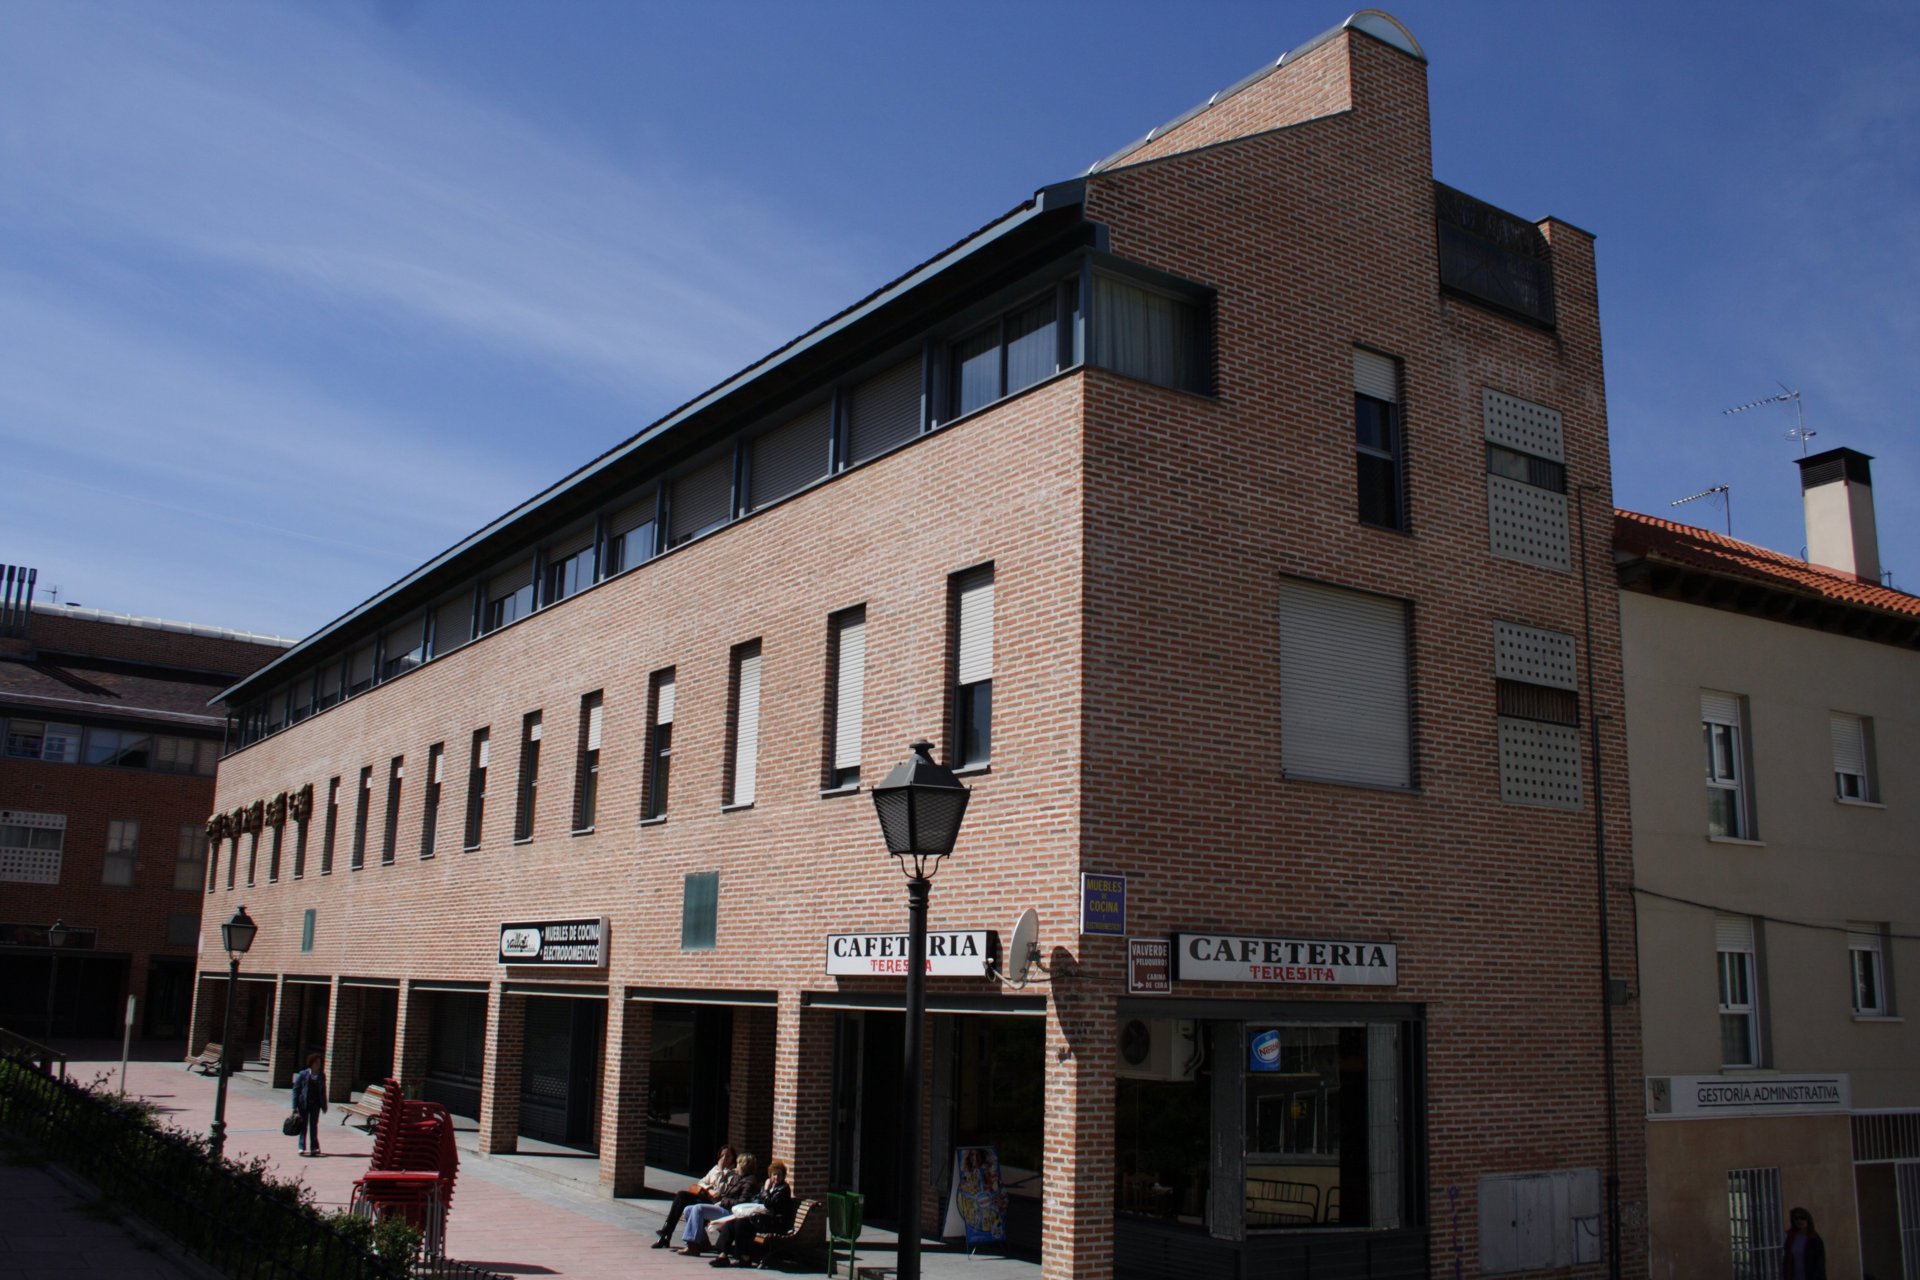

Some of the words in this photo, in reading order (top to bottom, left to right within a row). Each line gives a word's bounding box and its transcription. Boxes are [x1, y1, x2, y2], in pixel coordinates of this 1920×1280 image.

[1087, 879, 1122, 893] MUEBLES
[1090, 900, 1119, 913] COCINA
[544, 925, 569, 941] MUEBLES
[569, 924, 577, 941] DE
[577, 924, 599, 940] COCINA
[543, 945, 598, 961] ELECTRODOMESTICOS
[833, 934, 979, 958] CAFETRIA
[1131, 944, 1168, 957] VALVERDE
[1189, 938, 1389, 968] CAFETERIA
[870, 959, 932, 974] TERESA
[1136, 957, 1168, 967] PELUQUEROS
[1249, 965, 1336, 982] TERESITA
[1145, 981, 1153, 989] DE
[1697, 1085, 1751, 1103] GESTORÍA
[1754, 1085, 1840, 1101] ADMINISTRATIVA
